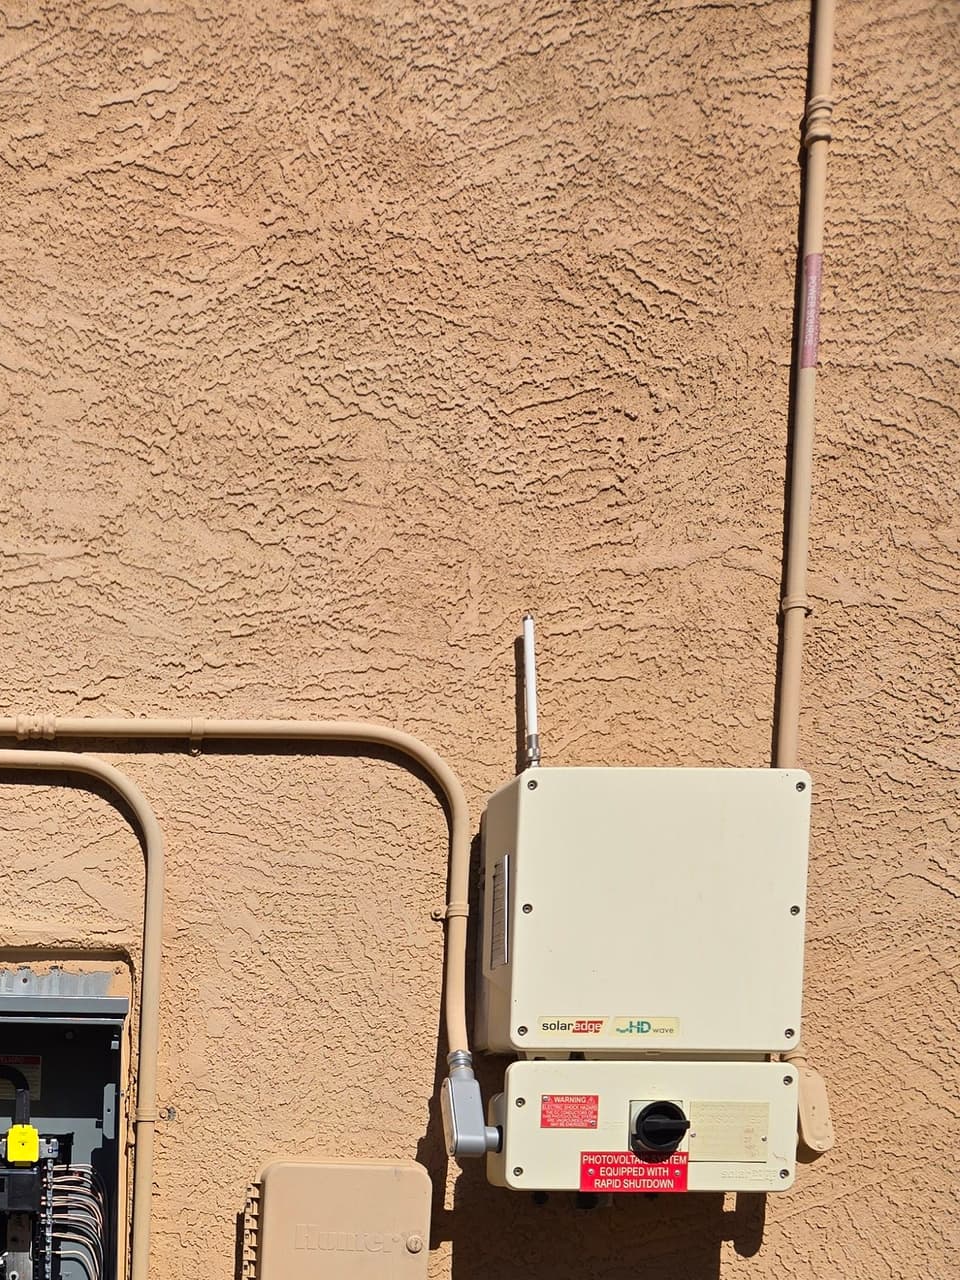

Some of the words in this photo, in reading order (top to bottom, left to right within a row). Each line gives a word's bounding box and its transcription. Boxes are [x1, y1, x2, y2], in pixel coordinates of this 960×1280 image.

[805, 308, 816, 345] SOURCE
[542, 1020, 603, 1033] solaredge
[629, 1021, 651, 1033] HD
[600, 1167, 645, 1177] EQUIPPED
[647, 1167, 669, 1176] WITH
[594, 1179, 621, 1188] RAPID
[623, 1179, 674, 1188] SHUTDOWN
